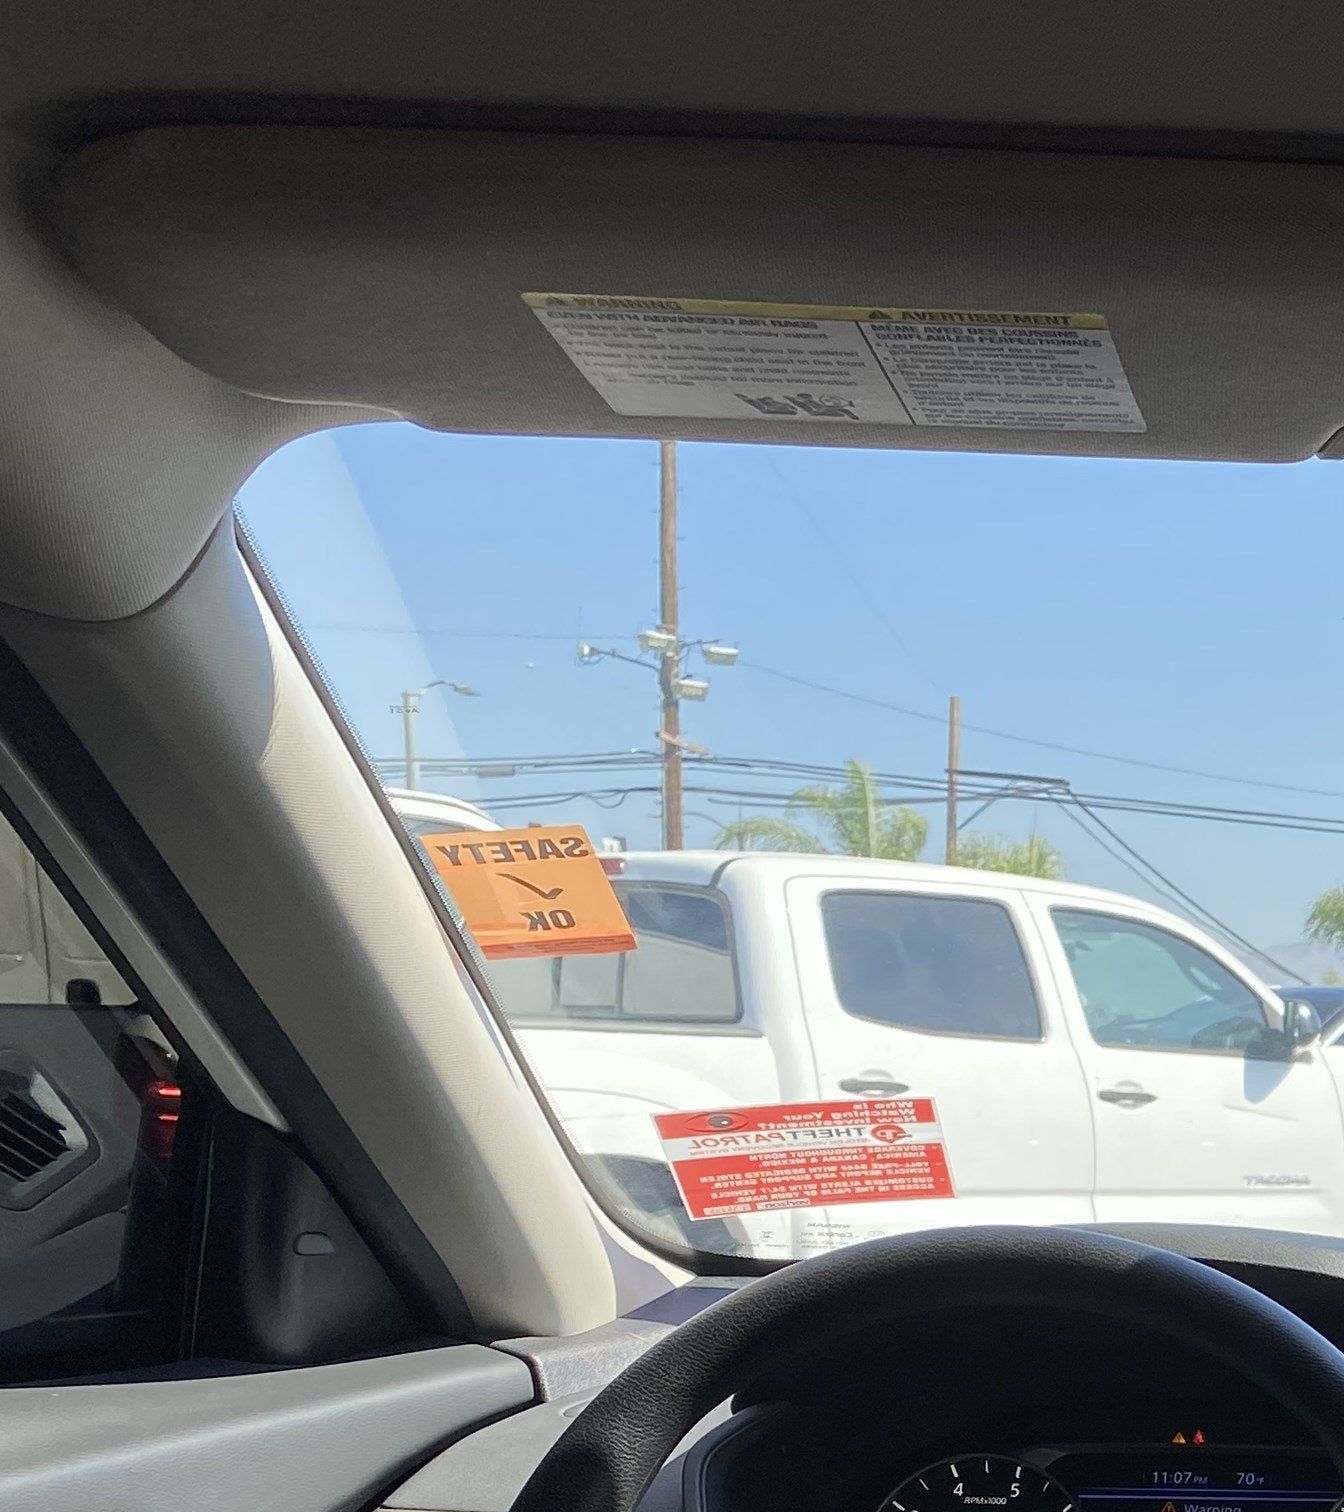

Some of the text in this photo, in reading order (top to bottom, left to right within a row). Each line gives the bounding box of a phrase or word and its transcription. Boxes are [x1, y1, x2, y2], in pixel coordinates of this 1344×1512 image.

[902, 310, 1070, 326] AVERTISSEMENT
[1152, 1471, 1193, 1484] 11:07
[953, 1482, 964, 1497] 4
[1010, 1483, 1020, 1498] 5
